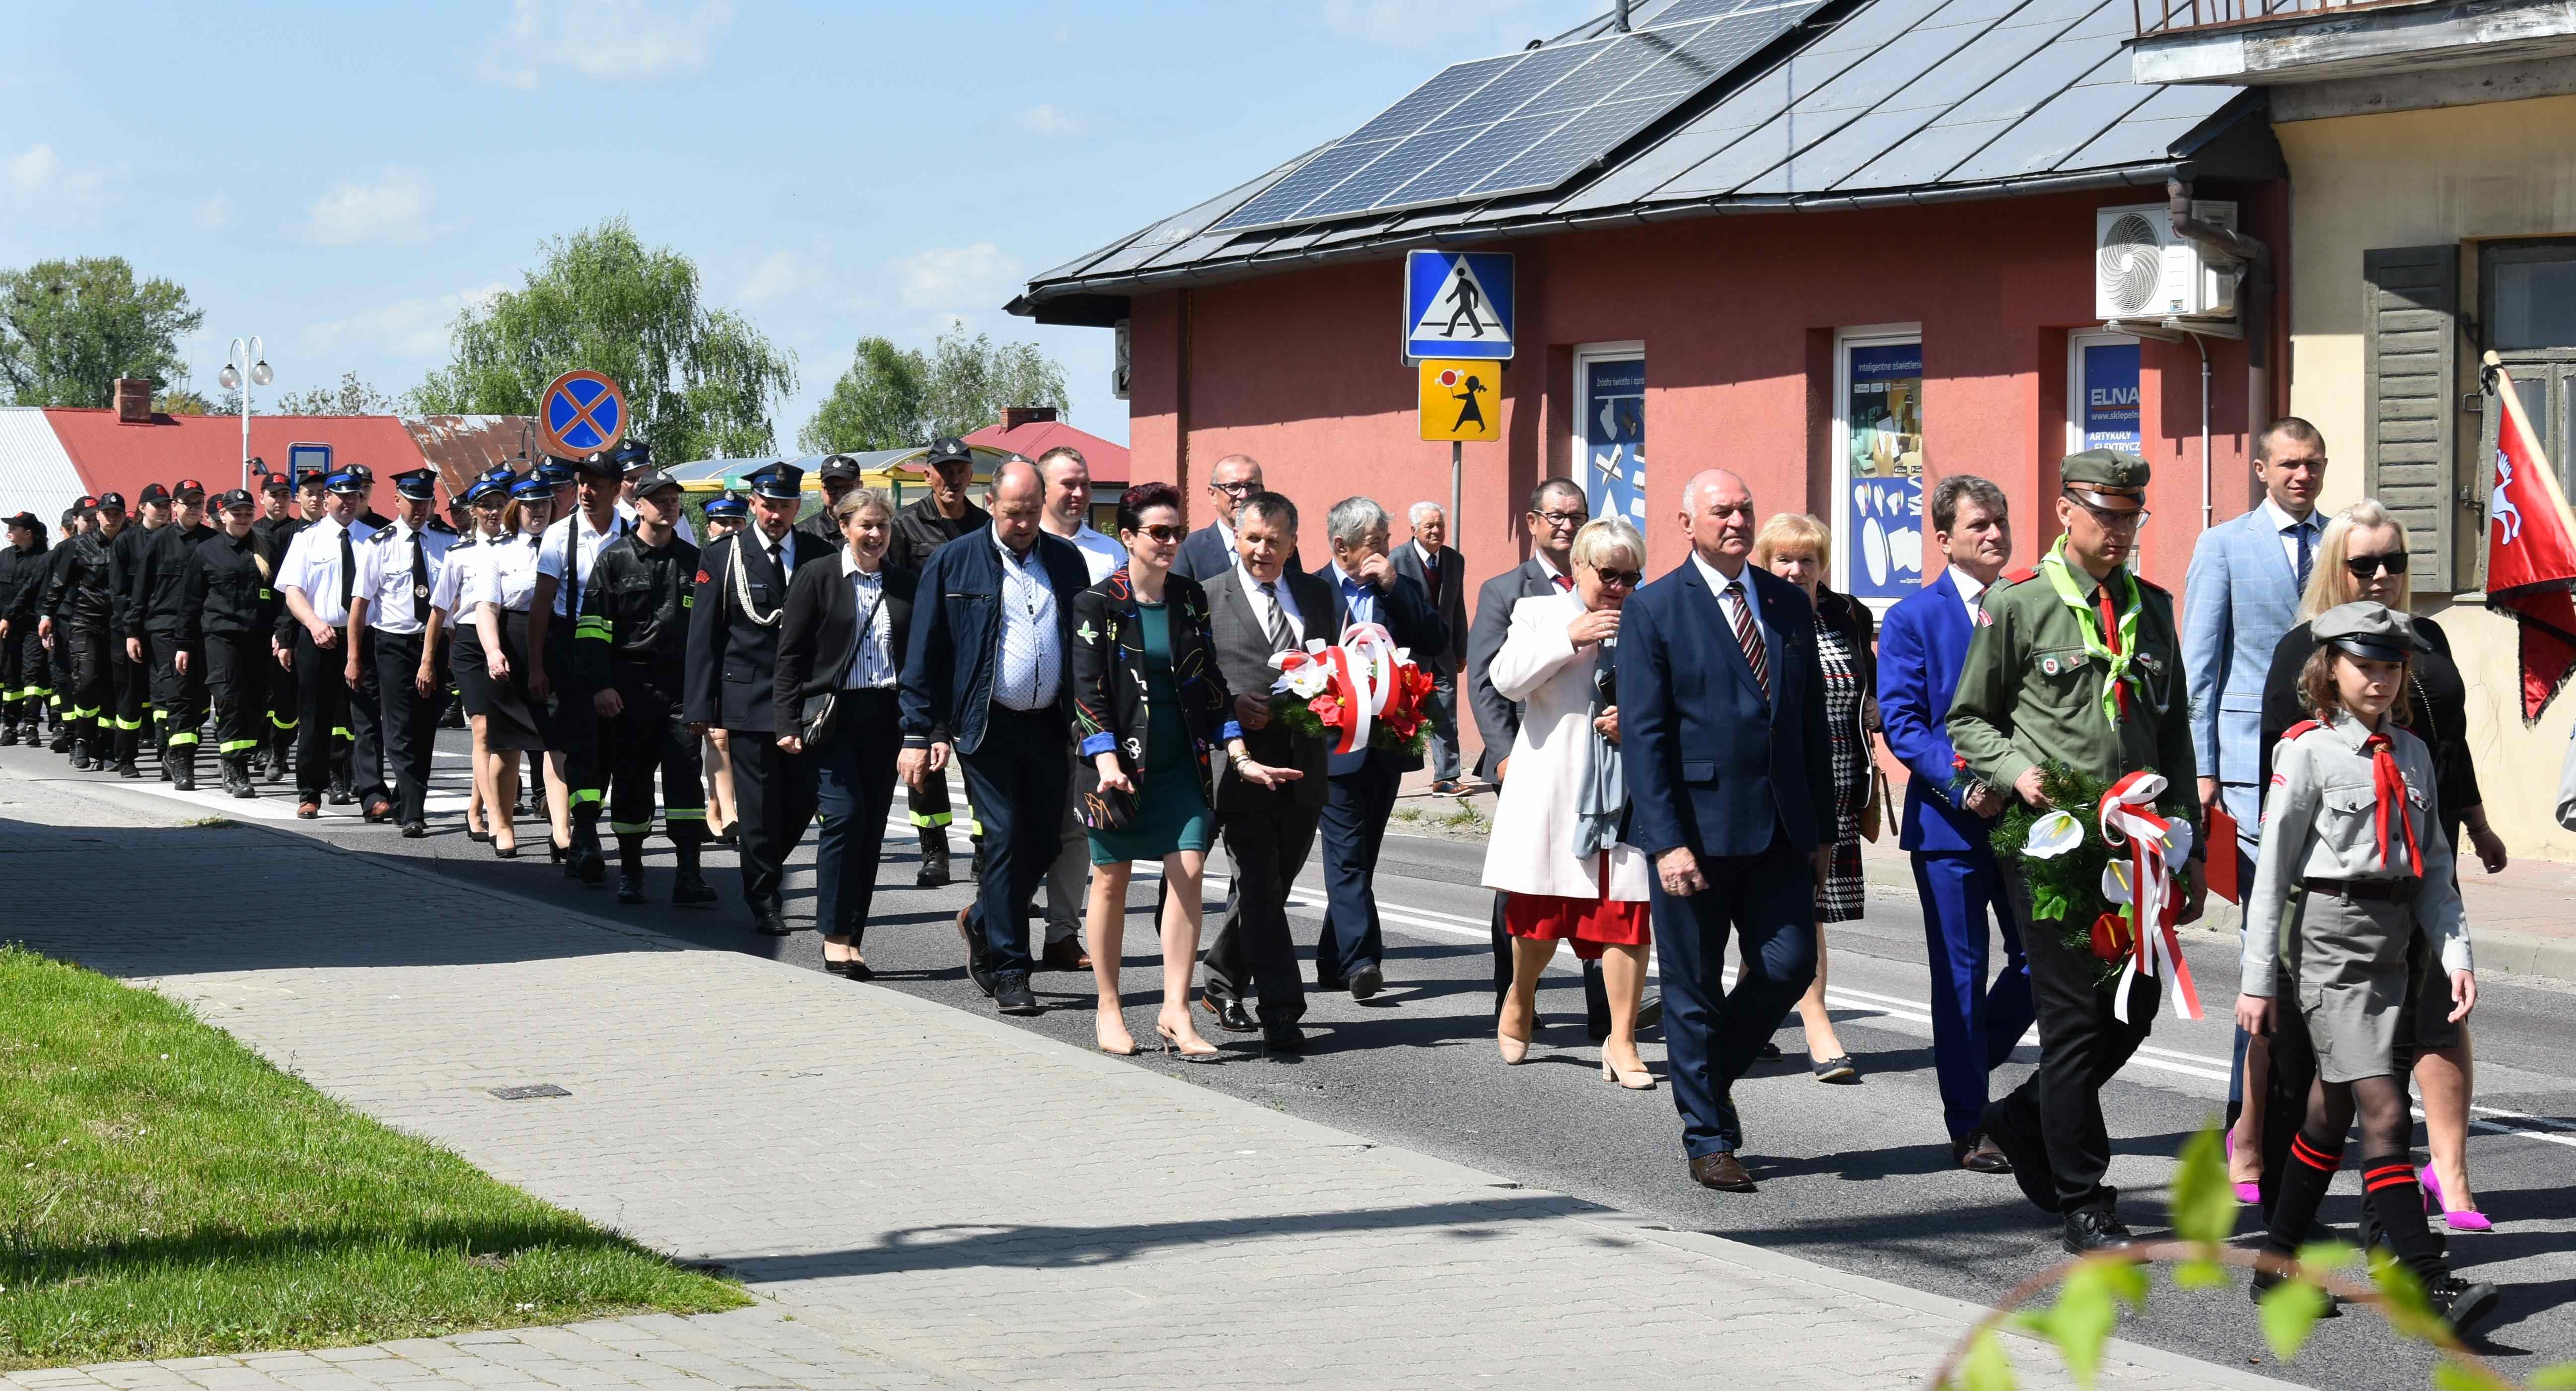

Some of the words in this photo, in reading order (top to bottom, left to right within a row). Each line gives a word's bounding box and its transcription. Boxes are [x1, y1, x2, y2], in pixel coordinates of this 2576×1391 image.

[1859, 362, 1891, 372] Inteligentne
[2091, 387, 2140, 406] ELNA
[2089, 431, 2131, 441] ARTYKUŁY
